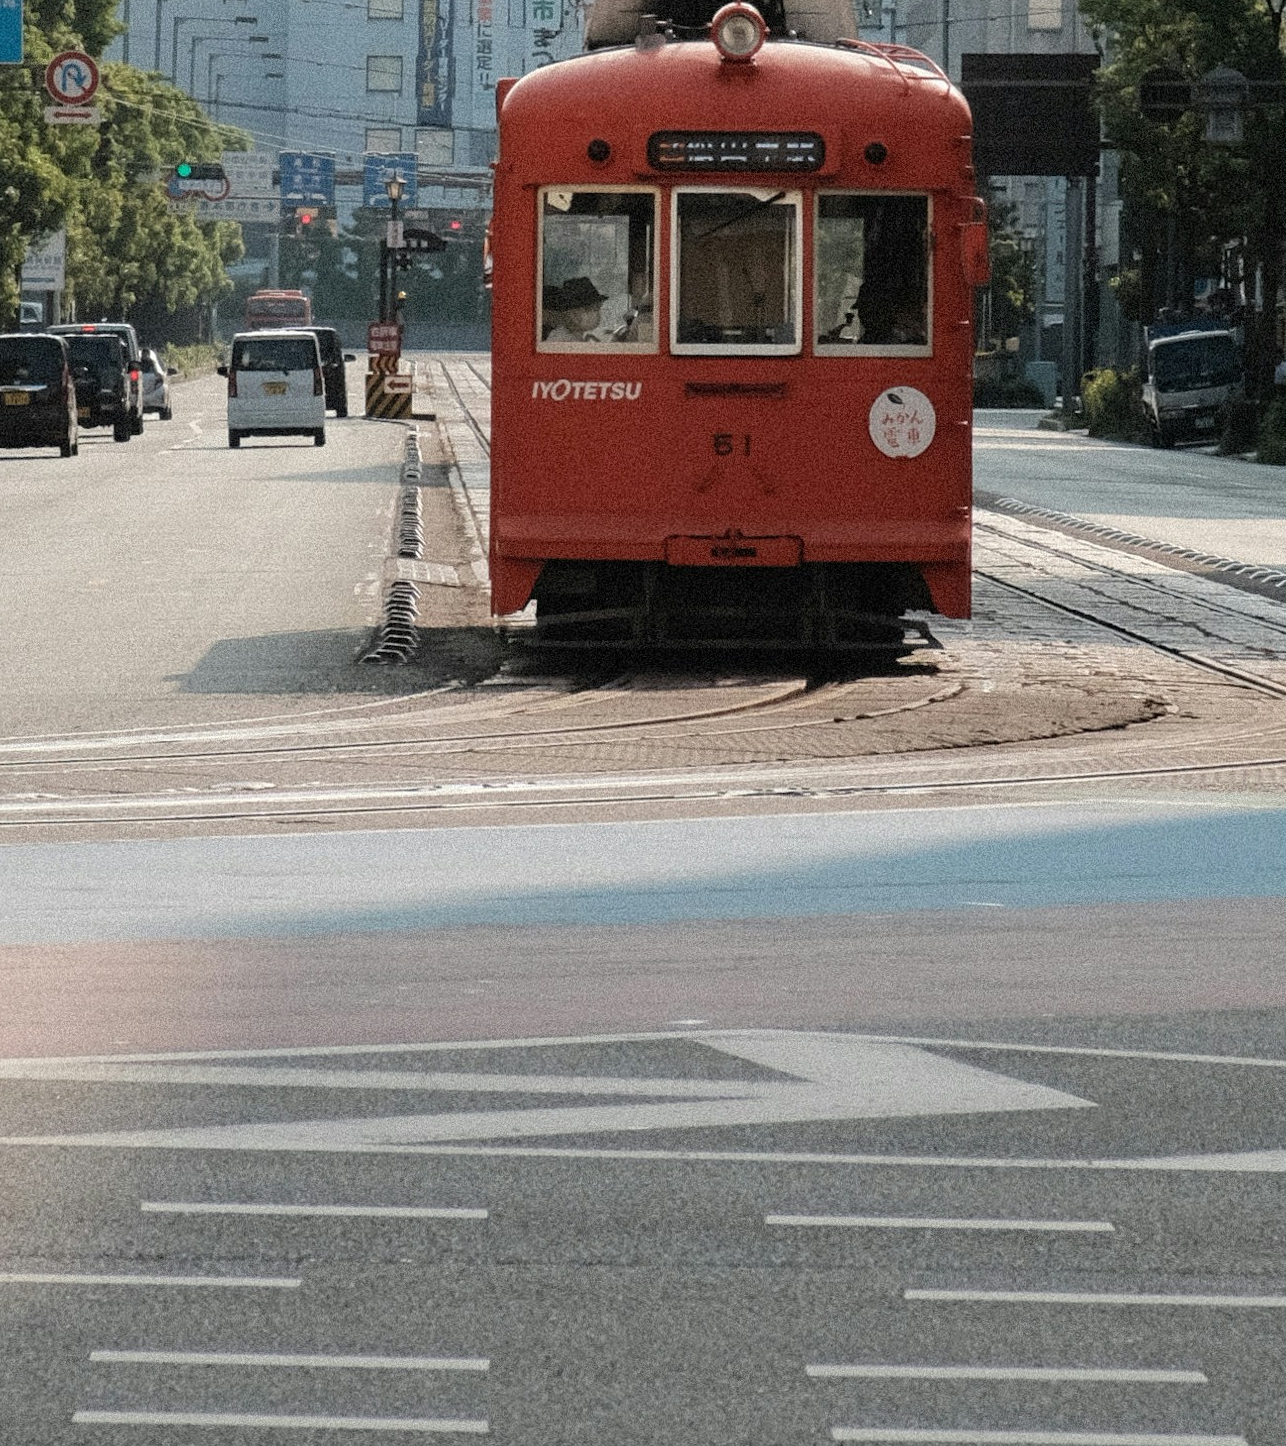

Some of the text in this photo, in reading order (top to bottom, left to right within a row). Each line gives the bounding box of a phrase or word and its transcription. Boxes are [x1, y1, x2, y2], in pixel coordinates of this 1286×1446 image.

[531, 377, 642, 403] IYOTETSU
[881, 409, 924, 425] みかん
